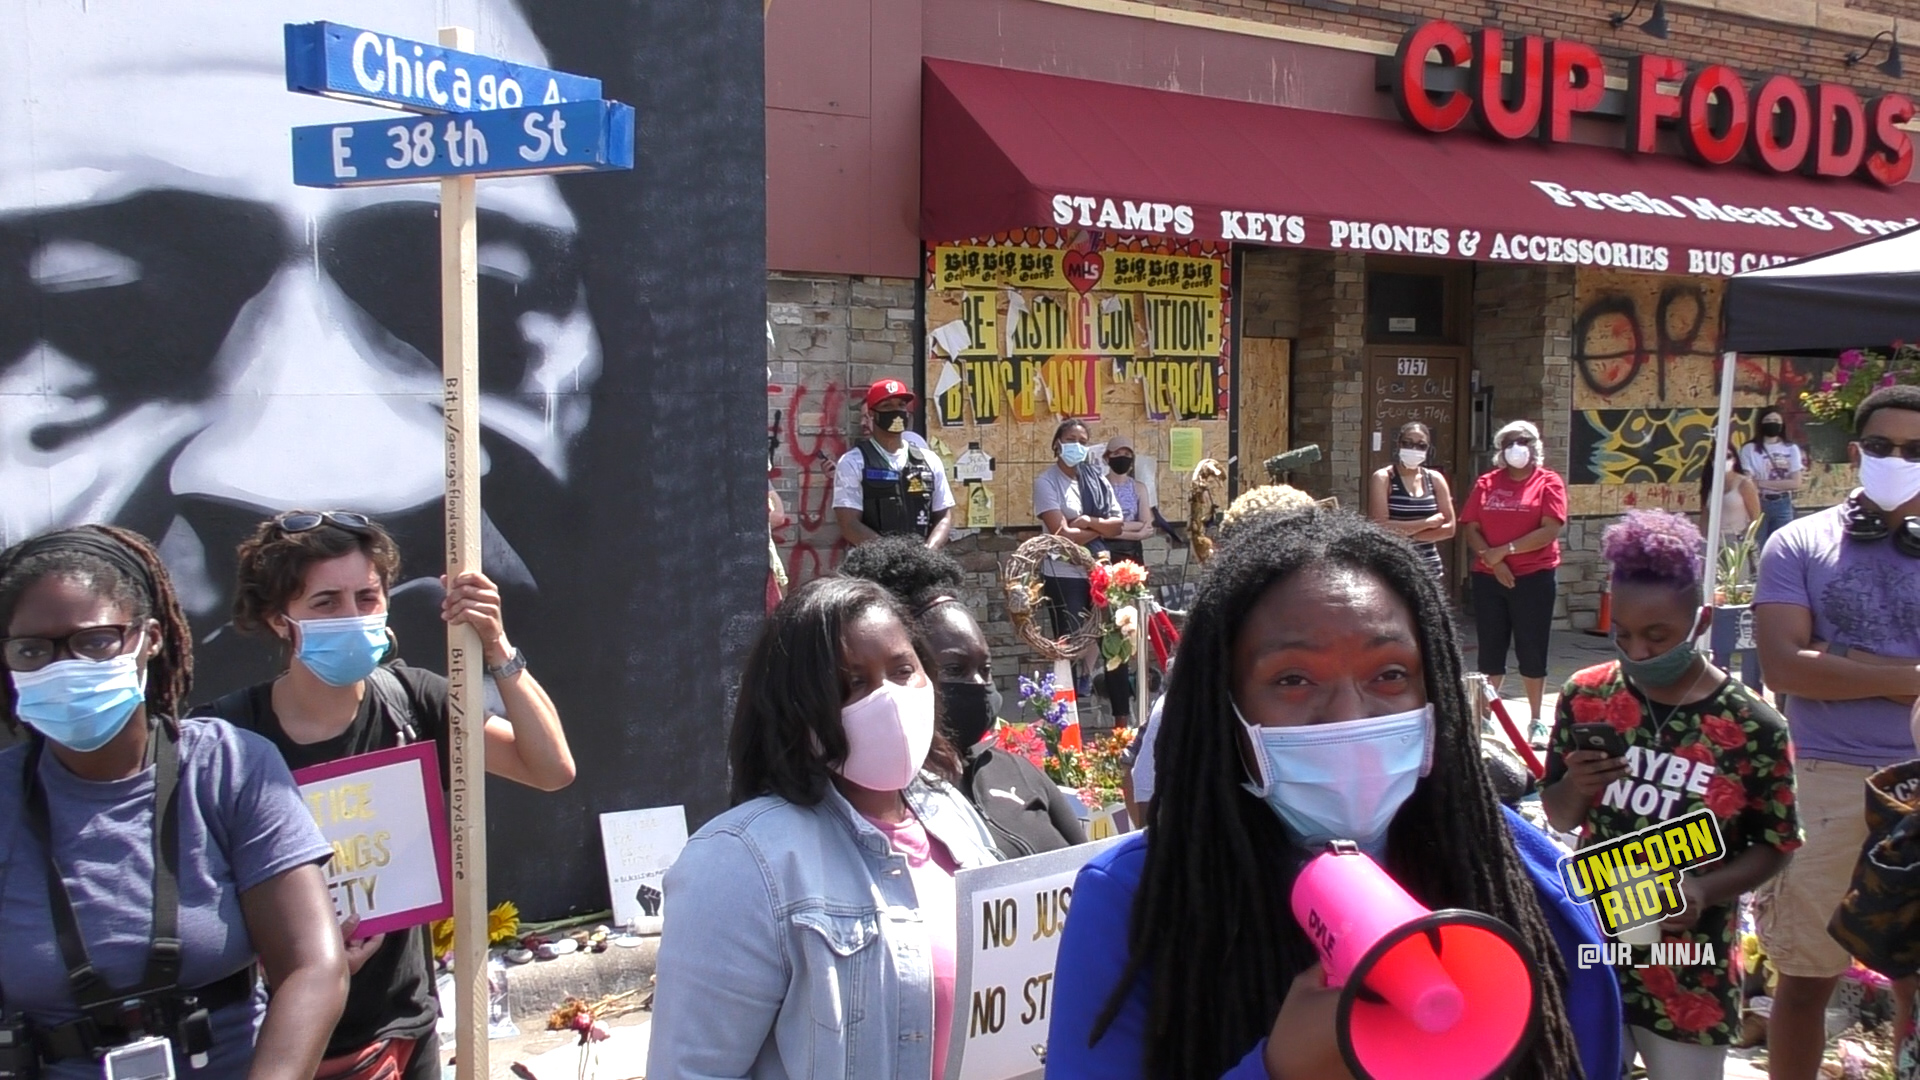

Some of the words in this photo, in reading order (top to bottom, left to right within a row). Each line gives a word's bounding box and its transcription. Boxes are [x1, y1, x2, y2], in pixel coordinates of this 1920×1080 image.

[352, 30, 524, 112] Chicago
[541, 78, 582, 106] A
[1395, 19, 1606, 142] CUP
[1625, 53, 1918, 187] FOODS
[331, 126, 358, 179] E
[385, 119, 490, 170] 38th
[518, 109, 569, 163] St
[1530, 179, 1687, 219] Fresh
[1673, 195, 1798, 230] Meat
[1788, 205, 1834, 232] &
[1828, 210, 1920, 236] Pro
[1051, 193, 1195, 235] STAMPS
[1219, 210, 1306, 244] KEYS
[1328, 219, 1450, 256] PHONES
[1457, 229, 1481, 258] &
[1488, 232, 1669, 272] ACCESSORIES
[1687, 248, 1736, 276] BUS
[1019, 252, 1054, 272] Big
[1114, 256, 1147, 275] Big
[1148, 258, 1180, 277] Big
[1181, 261, 1213, 280] Big
[1398, 358, 1427, 375] 3757
[1376, 399, 1421, 420] George
[1625, 745, 1716, 796] AYBE
[309, 782, 376, 827] TICE
[1601, 778, 1682, 821] NOT
[328, 831, 392, 877] INGS
[982, 897, 1018, 951] NO
[1032, 885, 1073, 942] JUS
[970, 985, 1007, 1039] NO
[1020, 972, 1053, 1026] ST
